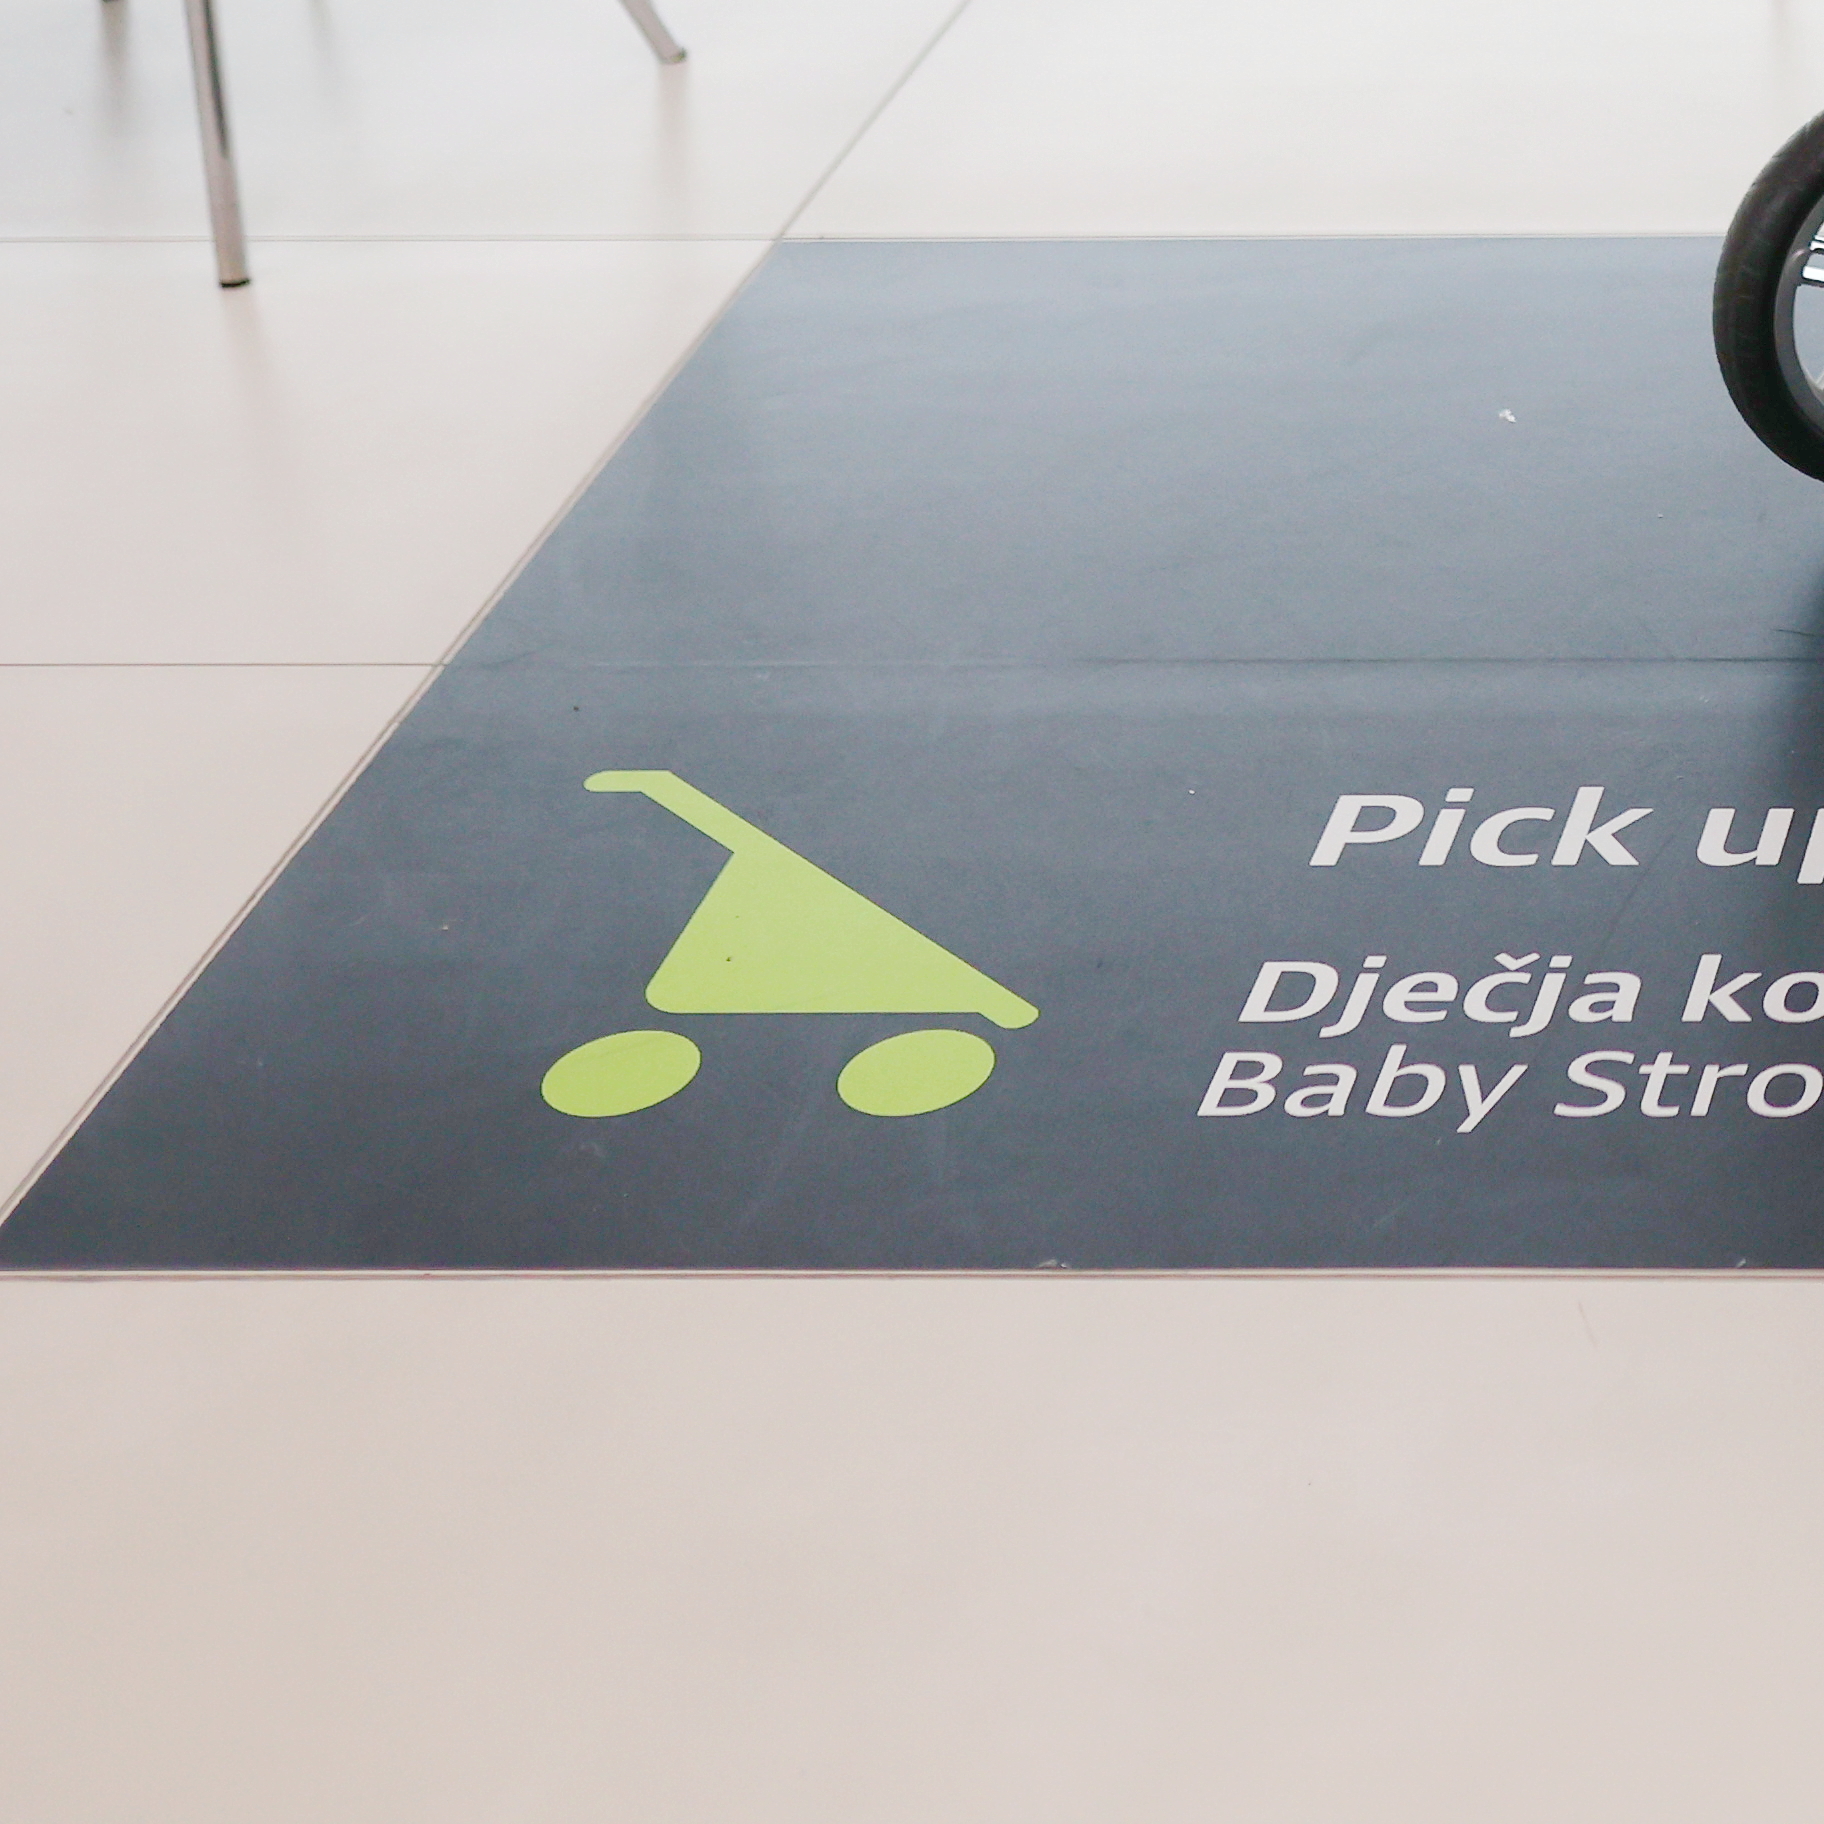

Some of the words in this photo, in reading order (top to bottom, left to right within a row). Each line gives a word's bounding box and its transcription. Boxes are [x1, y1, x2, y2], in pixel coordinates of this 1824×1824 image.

[1308, 786, 1655, 867] Pick
[1237, 952, 1642, 1039] Dječja
[1196, 1043, 1529, 1134] Baby
